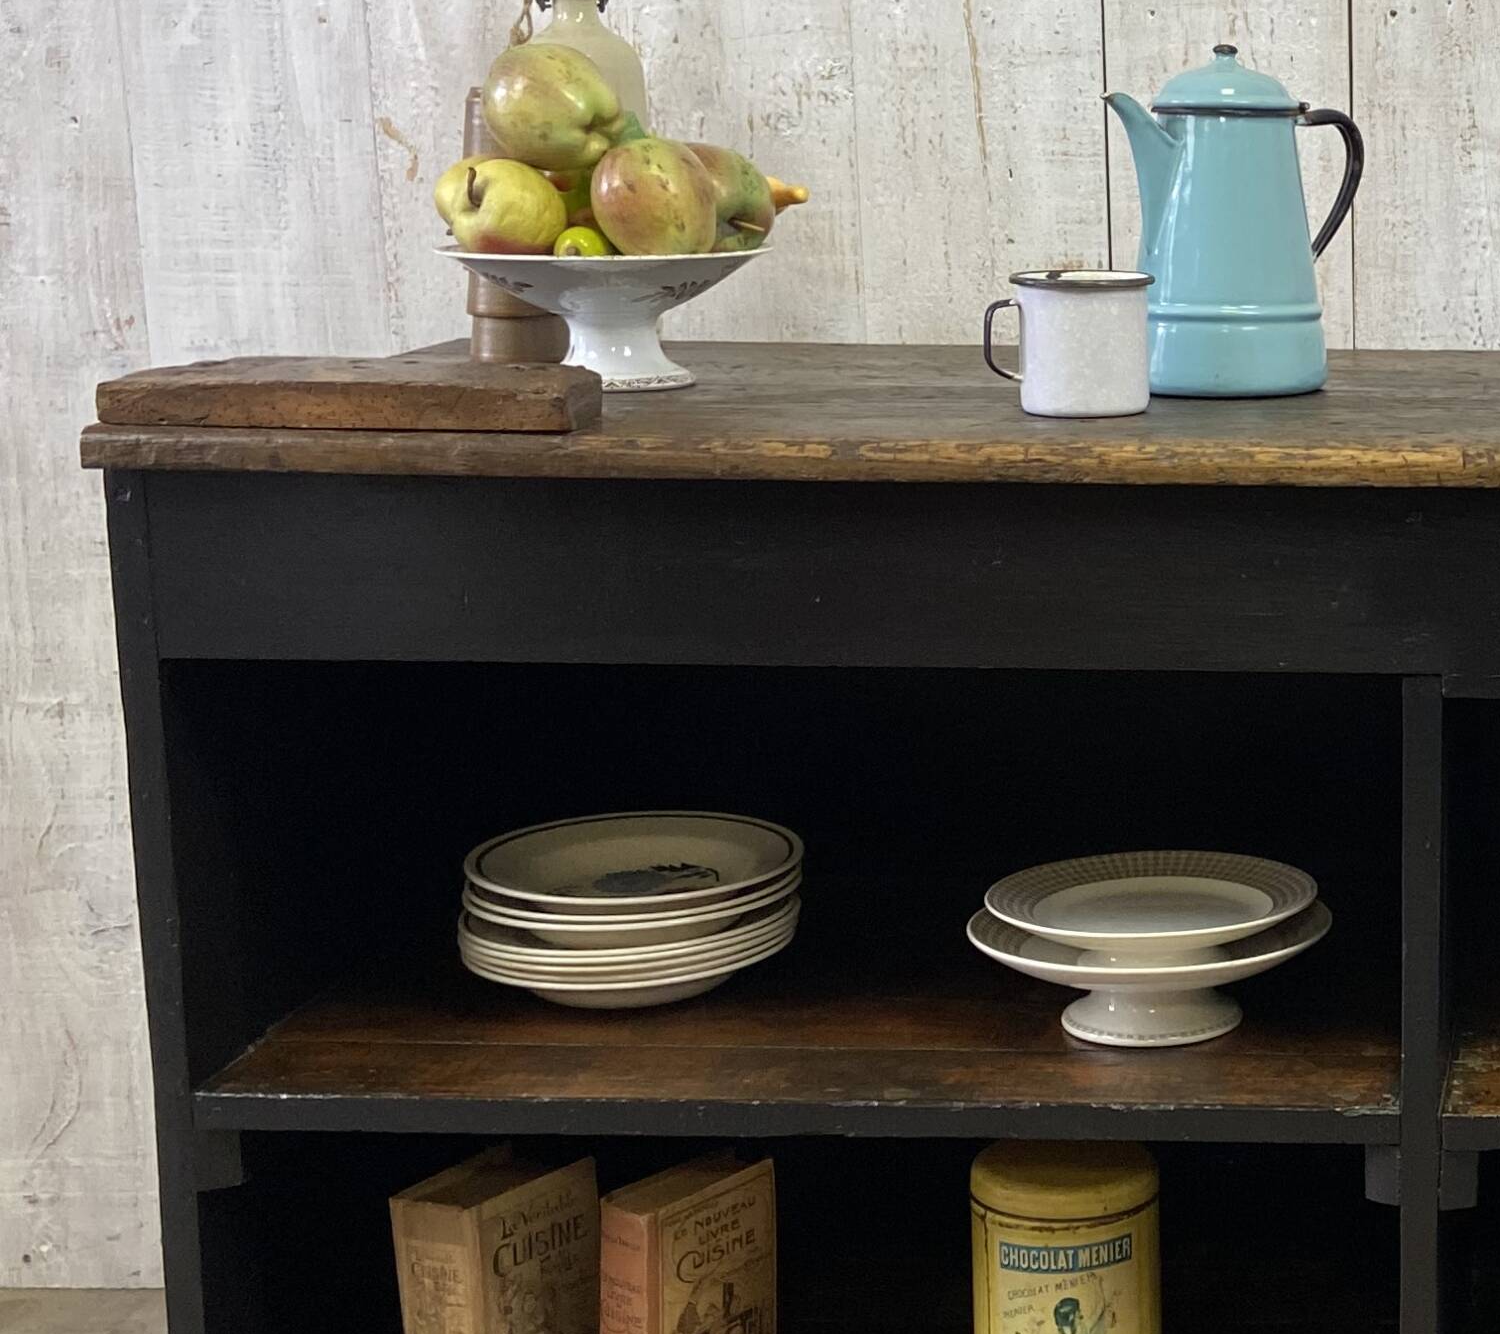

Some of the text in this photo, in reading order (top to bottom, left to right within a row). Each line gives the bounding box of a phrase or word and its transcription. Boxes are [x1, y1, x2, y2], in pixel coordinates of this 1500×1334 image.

[492, 1213, 589, 1278] CUISINE
[699, 1218, 741, 1245] LIVRE
[676, 1227, 757, 1283] CUISINE
[1000, 1236, 1131, 1271] CHOCOLAT MENIER
[1008, 1271, 1098, 1301] CHOCOLAT MENIER
[1003, 1304, 1036, 1319] MENIER
